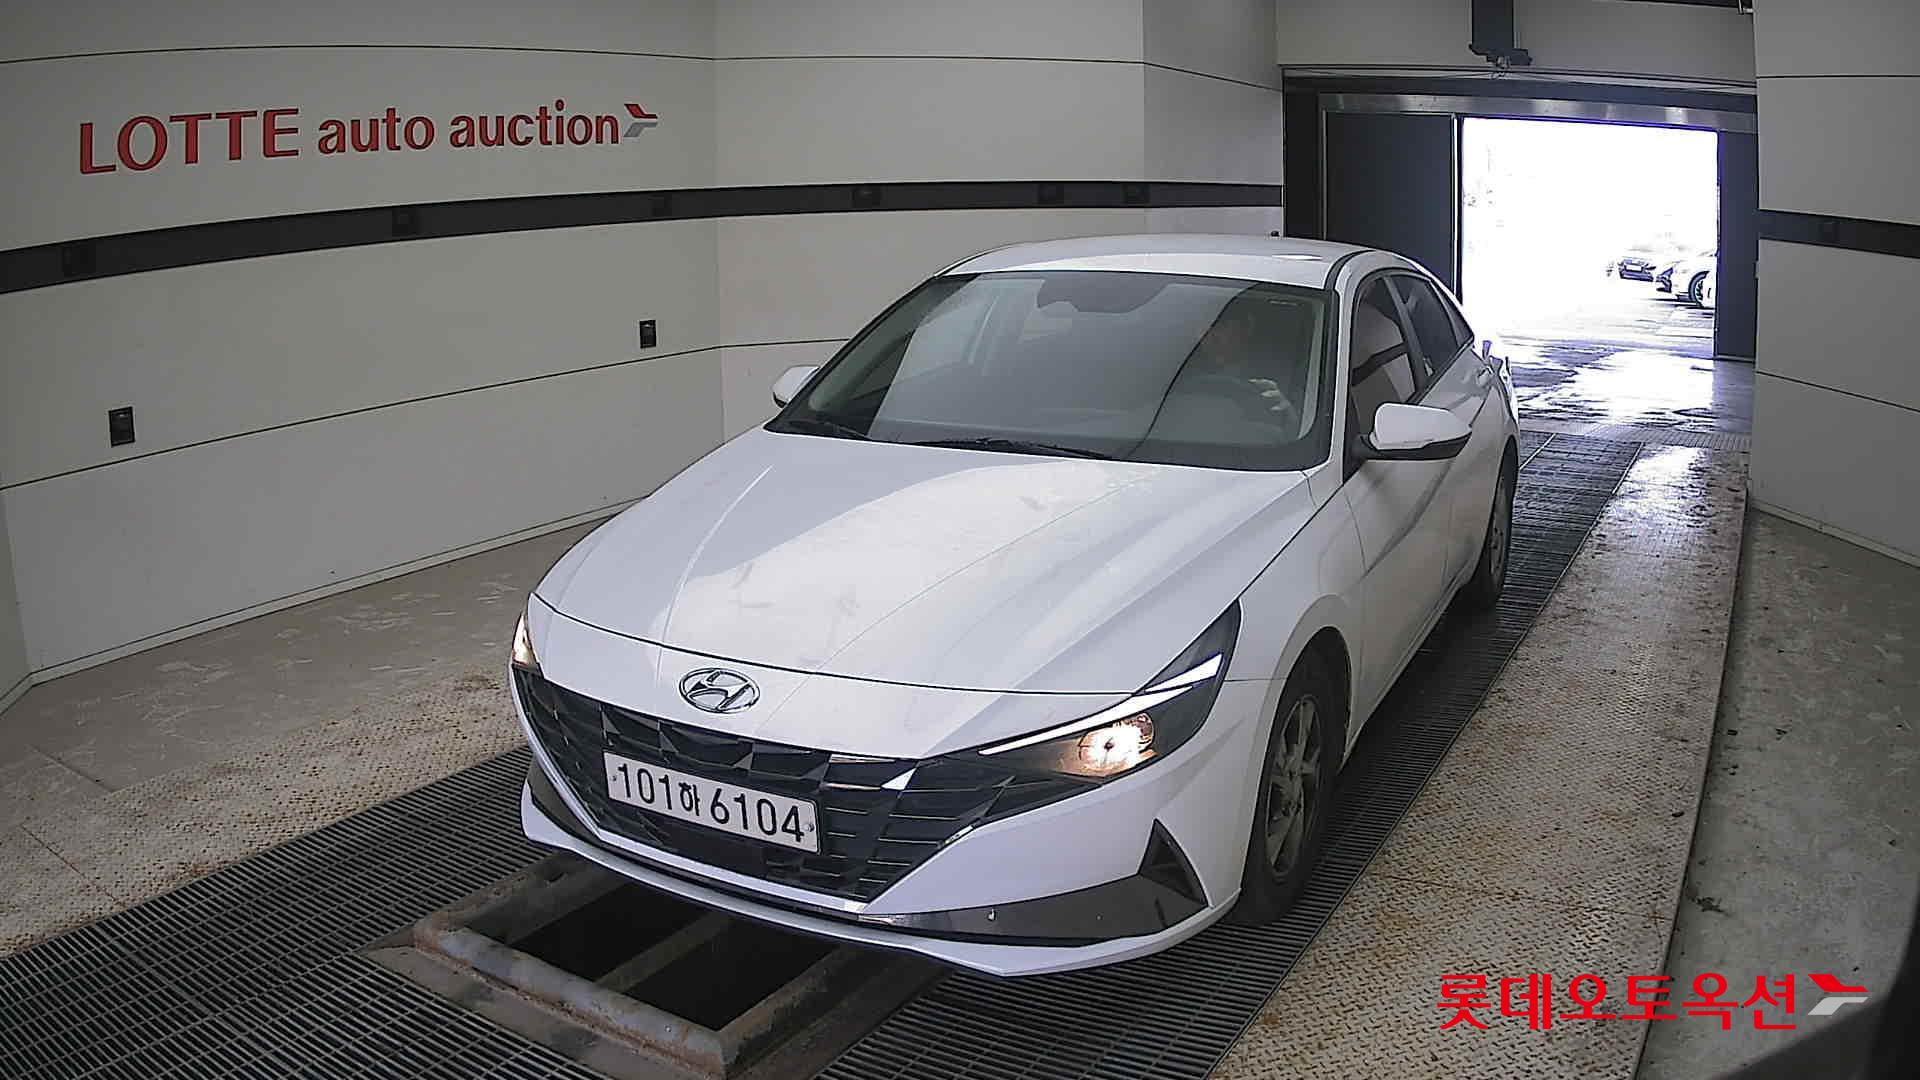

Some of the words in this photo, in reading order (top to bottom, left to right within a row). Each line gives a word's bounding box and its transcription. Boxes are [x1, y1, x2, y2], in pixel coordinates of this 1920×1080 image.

[79, 108, 300, 175] LOTTE
[317, 106, 435, 155] auto
[449, 99, 620, 147] auction
[617, 762, 701, 817] 101하
[710, 787, 805, 842] 6104
